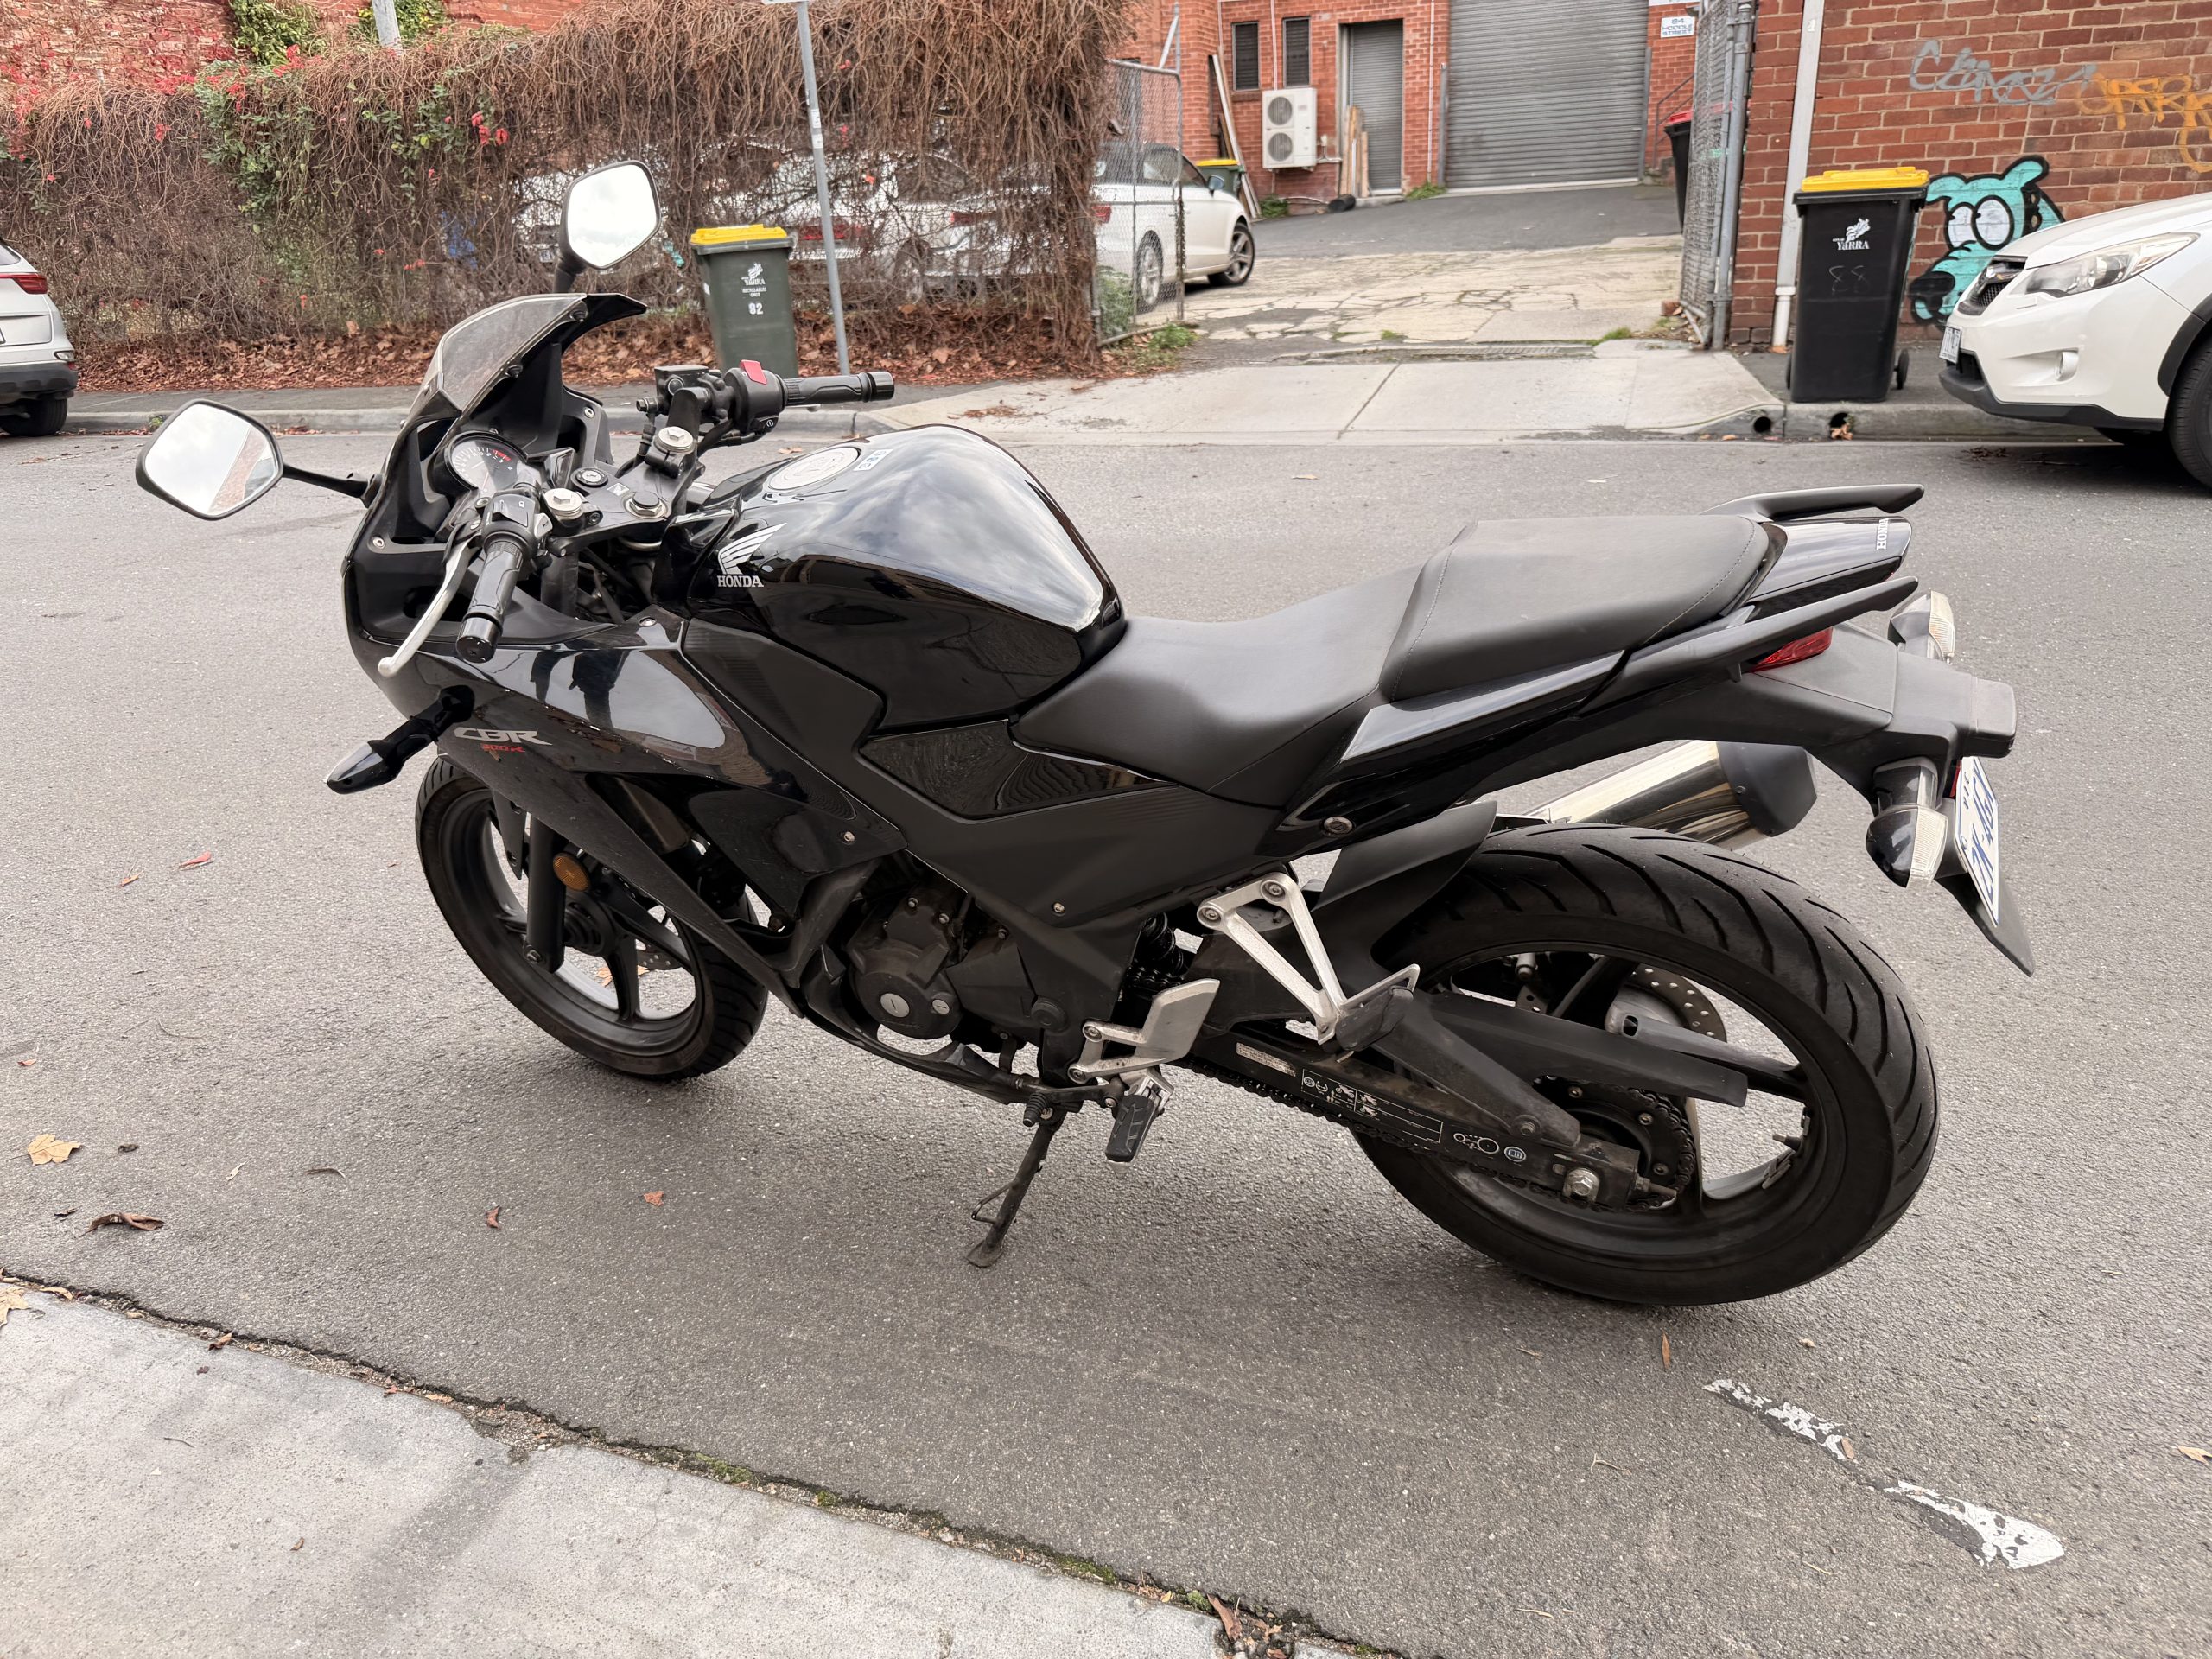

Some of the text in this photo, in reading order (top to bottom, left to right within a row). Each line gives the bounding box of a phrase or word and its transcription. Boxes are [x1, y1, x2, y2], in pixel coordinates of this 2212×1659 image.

[748, 302, 764, 315] 82
[1876, 518, 1889, 550] HONDA
[717, 575, 765, 588] HONDA
[454, 727, 553, 746] CBR
